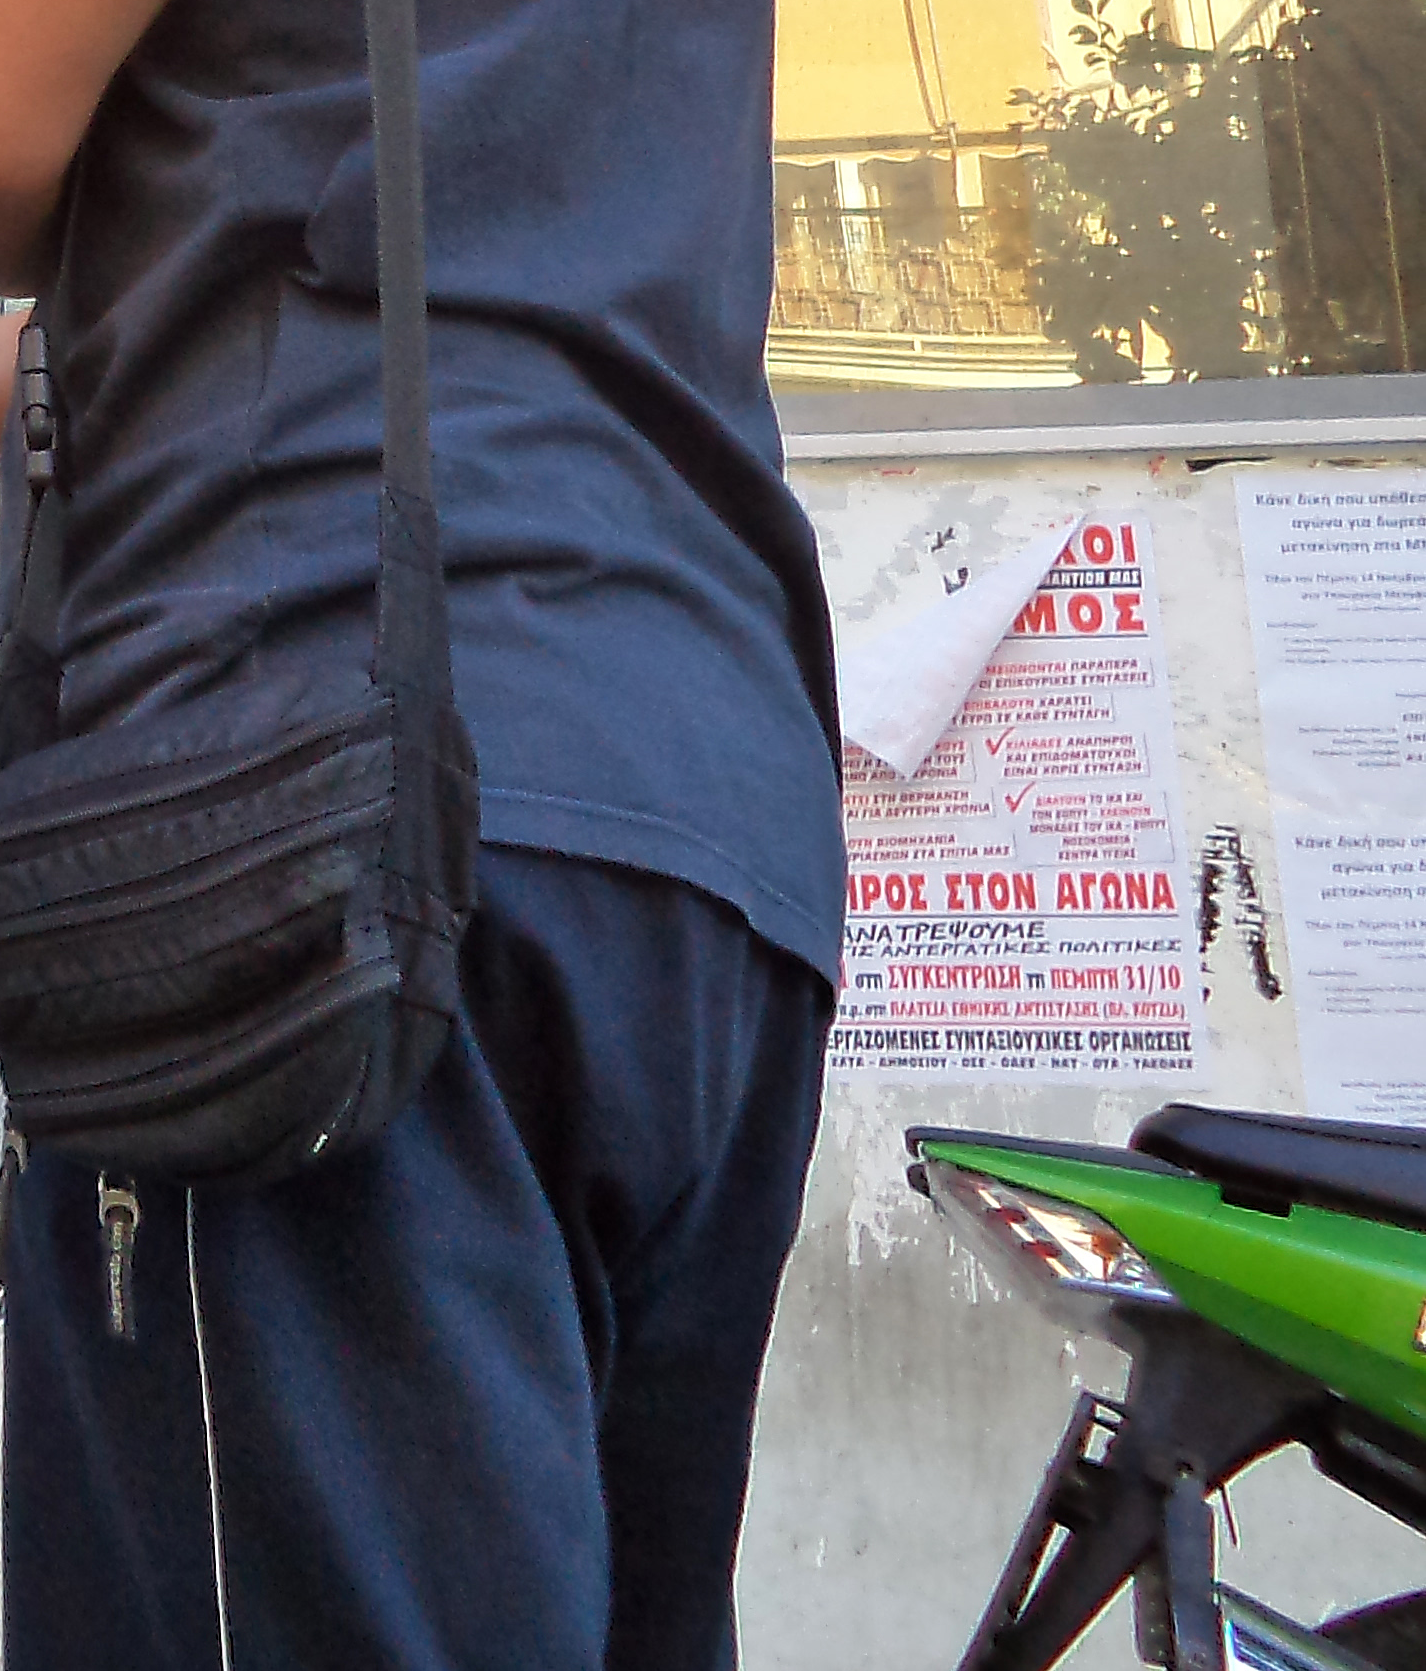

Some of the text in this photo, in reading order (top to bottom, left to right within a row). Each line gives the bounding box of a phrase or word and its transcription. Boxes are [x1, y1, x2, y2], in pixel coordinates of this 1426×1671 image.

[945, 872, 1038, 912] ΣΤΟΝ
[1056, 872, 1176, 912] ΑΓΩΝΑ
[880, 940, 1050, 958] ΑΝΤΕΡΓΑΤΙΚΕΣ
[1059, 939, 1183, 954] ΠΟΛΙΤΙΚΕΣ
[888, 965, 1021, 989] ΣΥΓΚΕΝΤΡΩΣΗ
[1050, 967, 1119, 990] ΠΕΜΠΤΗ
[1123, 964, 1181, 994] 31/10
[945, 1029, 1083, 1051] ΣΥΝΤΑΞΙΟΥΧΙΚΕΣ
[1089, 1031, 1192, 1051] ΟΡΓΑΝΩΣΕΙΣ
